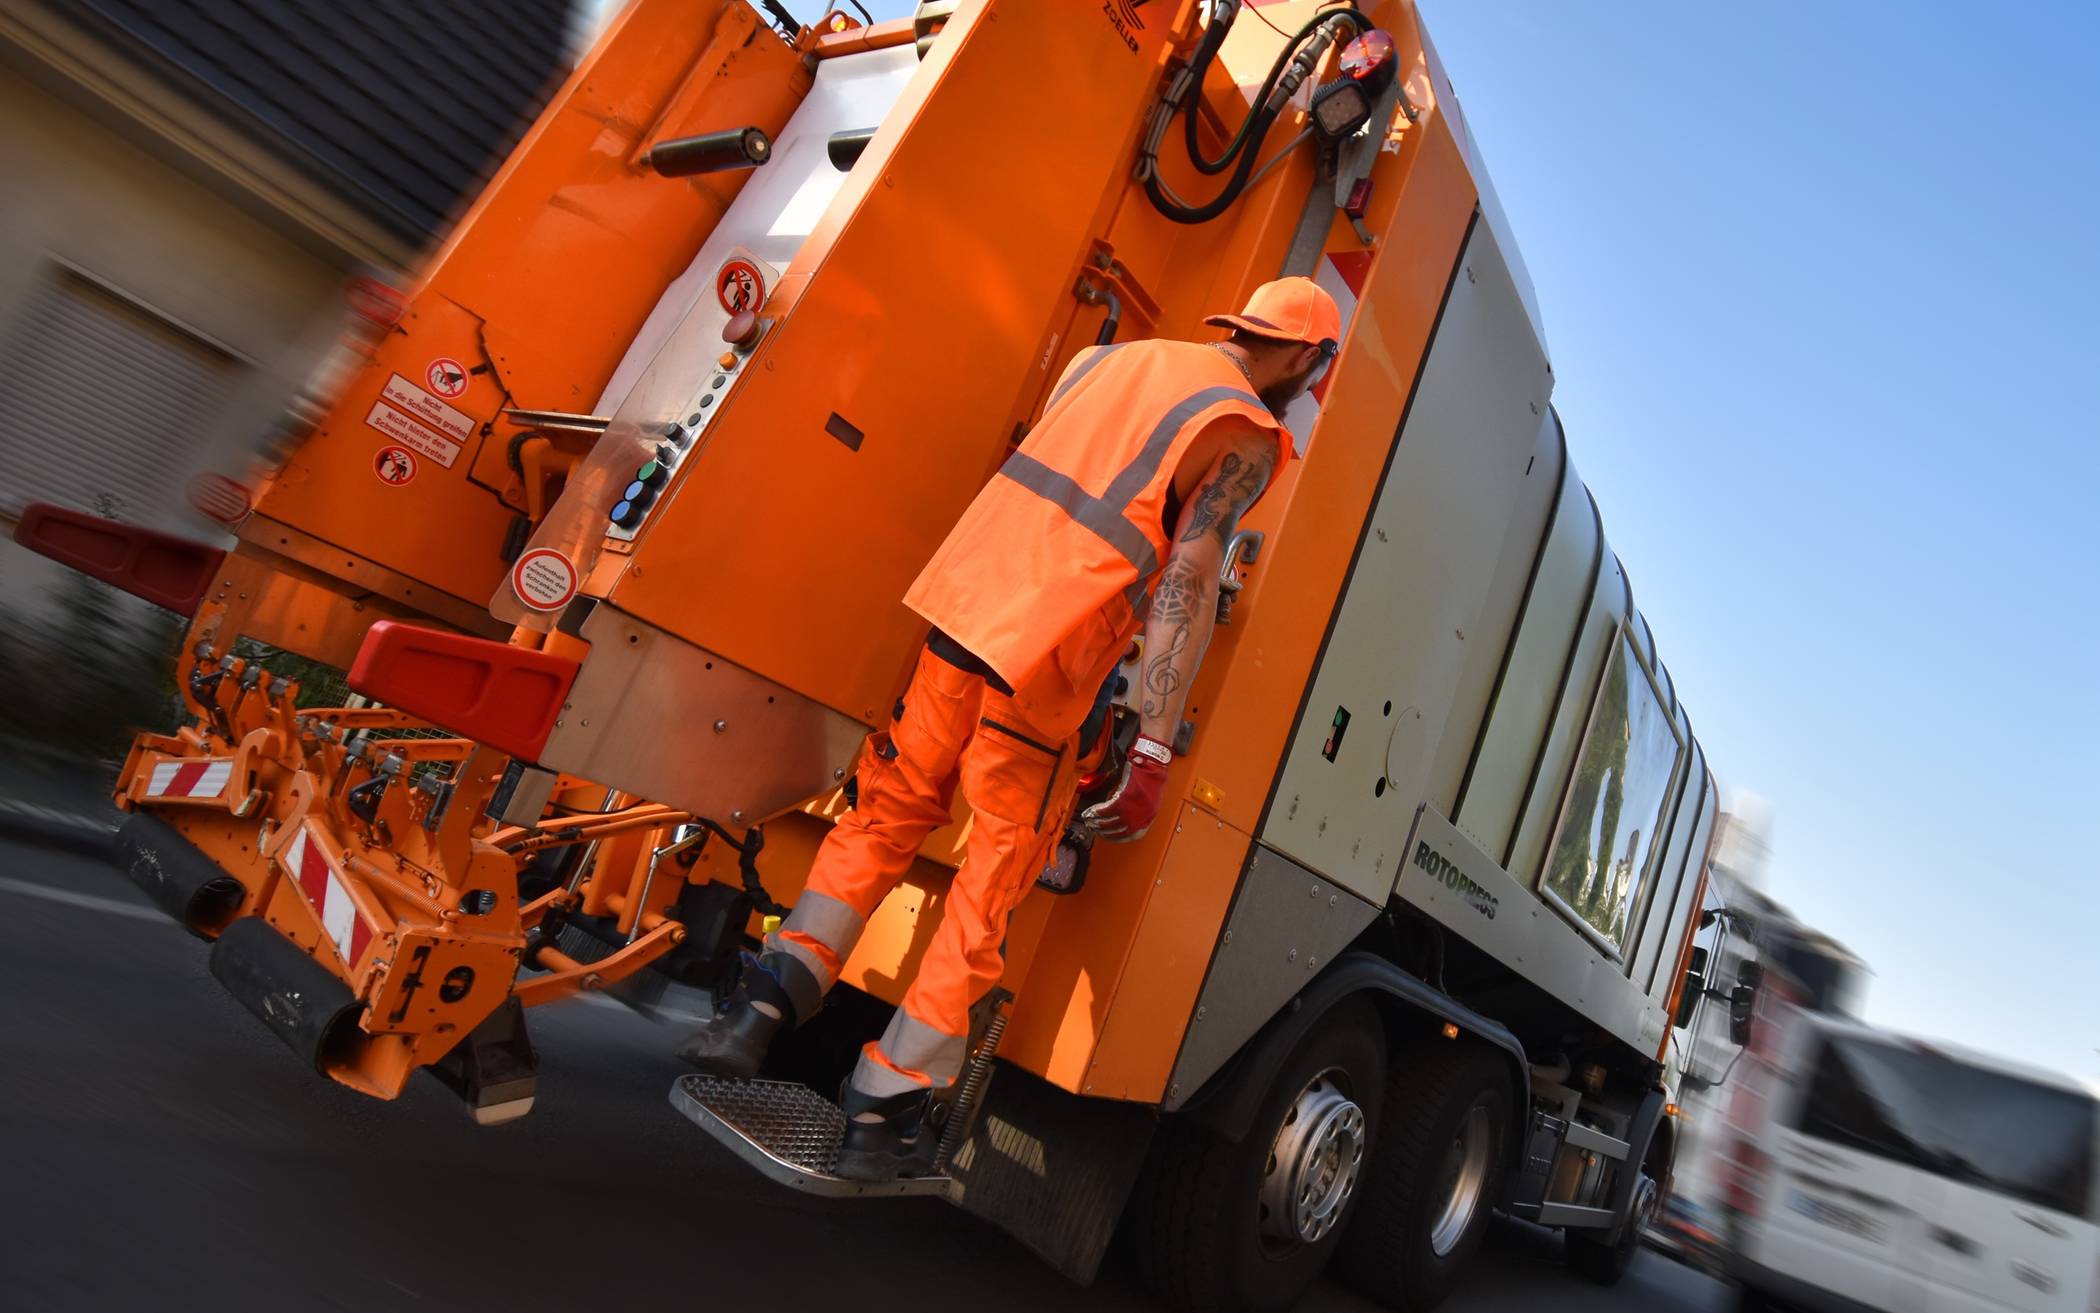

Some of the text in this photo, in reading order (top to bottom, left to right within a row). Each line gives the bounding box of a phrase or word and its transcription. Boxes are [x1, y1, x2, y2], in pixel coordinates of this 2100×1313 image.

[1103, 0, 1138, 55] ZOELLER
[394, 391, 407, 402] die
[406, 398, 443, 425] Schüttung
[442, 420, 468, 438] greifen
[423, 396, 442, 412] Nicht
[374, 417, 447, 463] Schwenkarm treten
[386, 411, 447, 450] Nicht hinter den
[525, 565, 567, 592] zwischen den
[526, 572, 557, 595] Schranken
[534, 560, 565, 582] Aufenthalt
[525, 582, 553, 600] verboten
